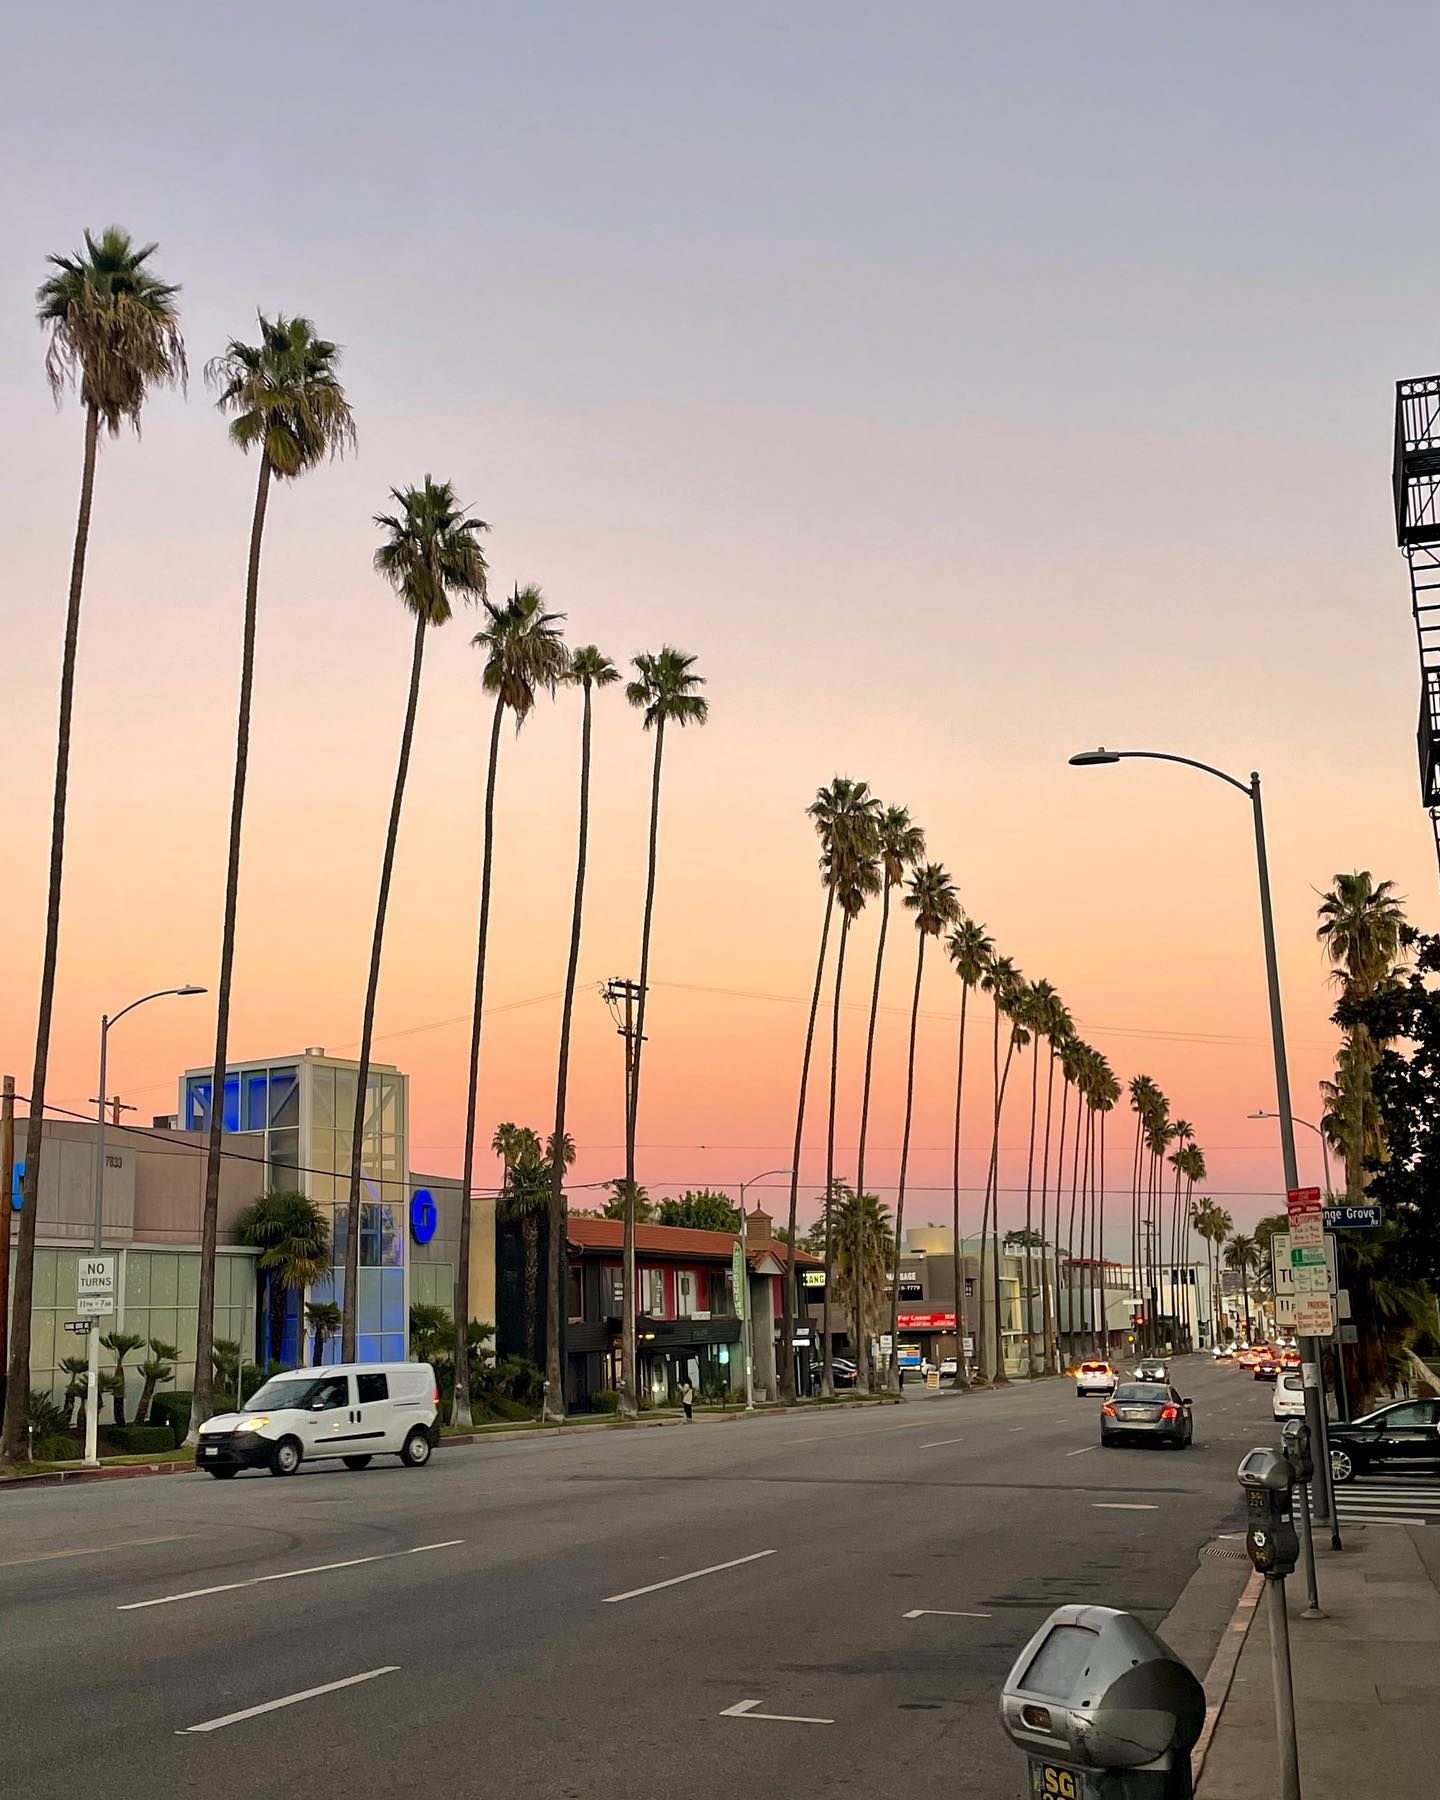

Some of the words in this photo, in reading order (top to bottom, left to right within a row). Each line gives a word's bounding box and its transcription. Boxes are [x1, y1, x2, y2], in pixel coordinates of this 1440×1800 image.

[1322, 1210, 1341, 1222] nge
[1346, 1208, 1374, 1219] Grove
[87, 1263, 105, 1274] NO
[81, 1277, 112, 1287] TURNS
[1045, 1767, 1074, 1798] SG
